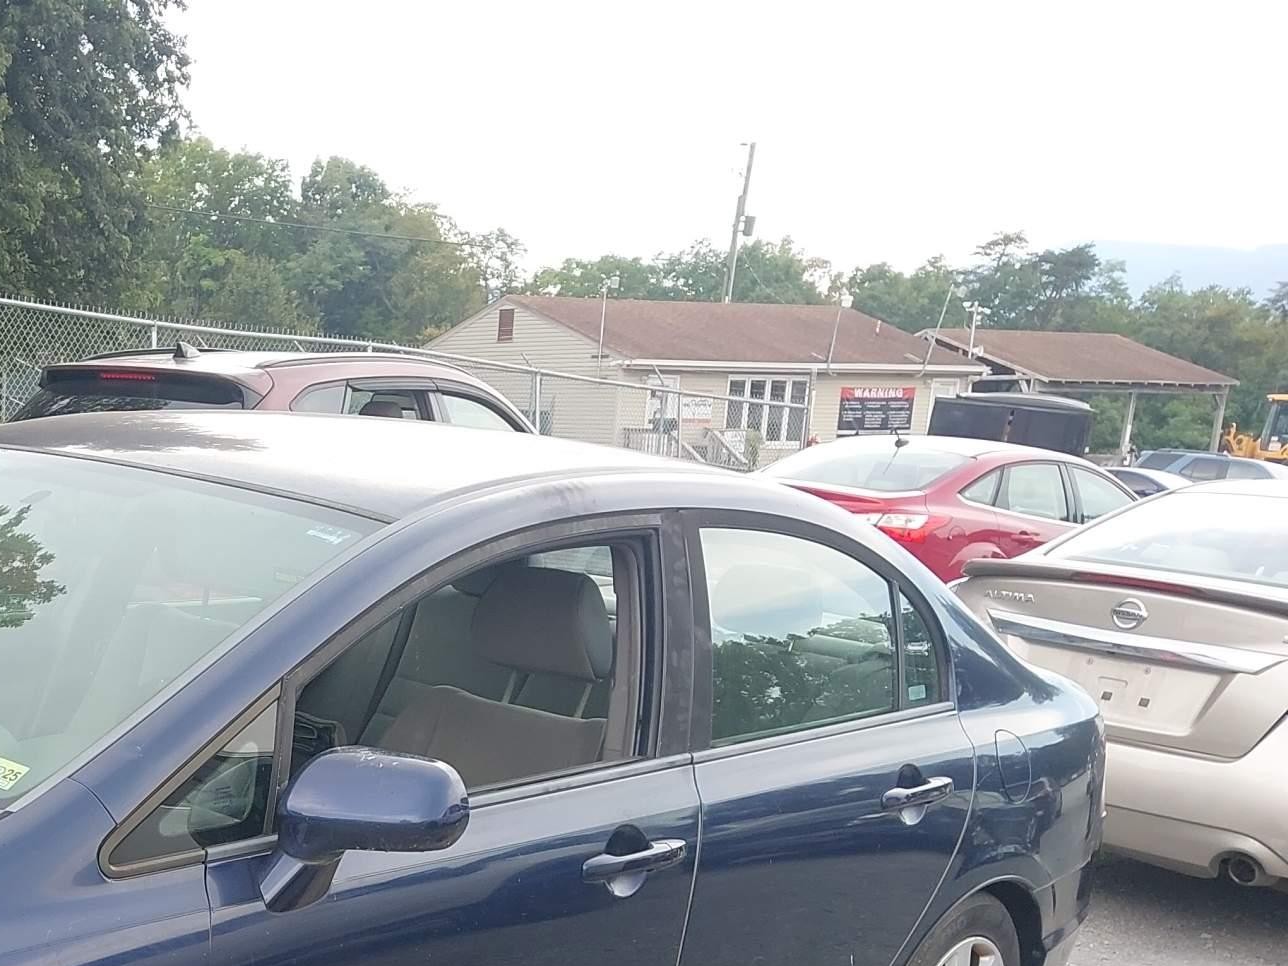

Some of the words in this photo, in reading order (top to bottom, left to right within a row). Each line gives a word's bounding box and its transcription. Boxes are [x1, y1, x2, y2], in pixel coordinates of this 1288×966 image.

[854, 387, 904, 398] WARNING
[984, 589, 1035, 603] ALTIMA
[2, 769, 22, 781] 25
